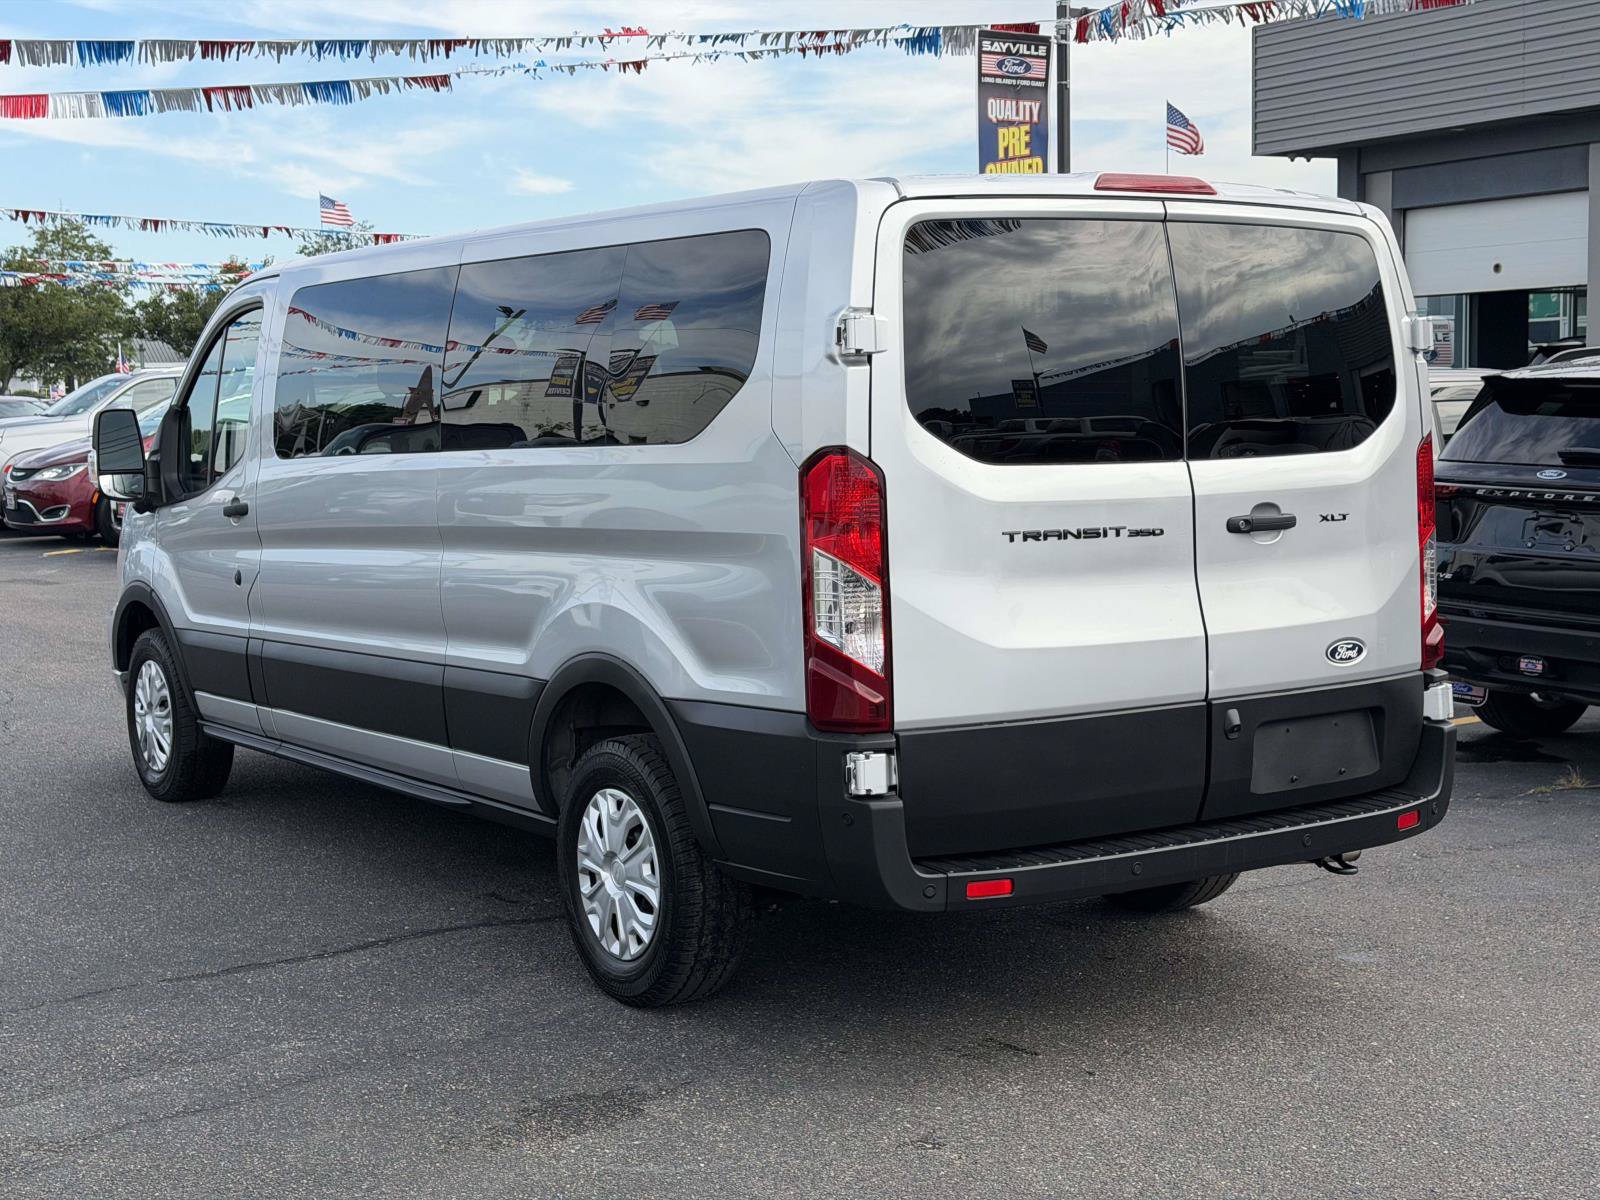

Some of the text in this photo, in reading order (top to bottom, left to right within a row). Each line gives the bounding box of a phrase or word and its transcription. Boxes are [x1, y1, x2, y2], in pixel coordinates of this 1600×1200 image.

[982, 40, 1047, 56] SAYVILLE
[1002, 59, 1026, 74] Ford
[987, 98, 1041, 123] QUALITY
[997, 126, 1031, 160] PRE
[1319, 512, 1351, 523] XLT
[1001, 525, 1165, 543] TRANSIT 350
